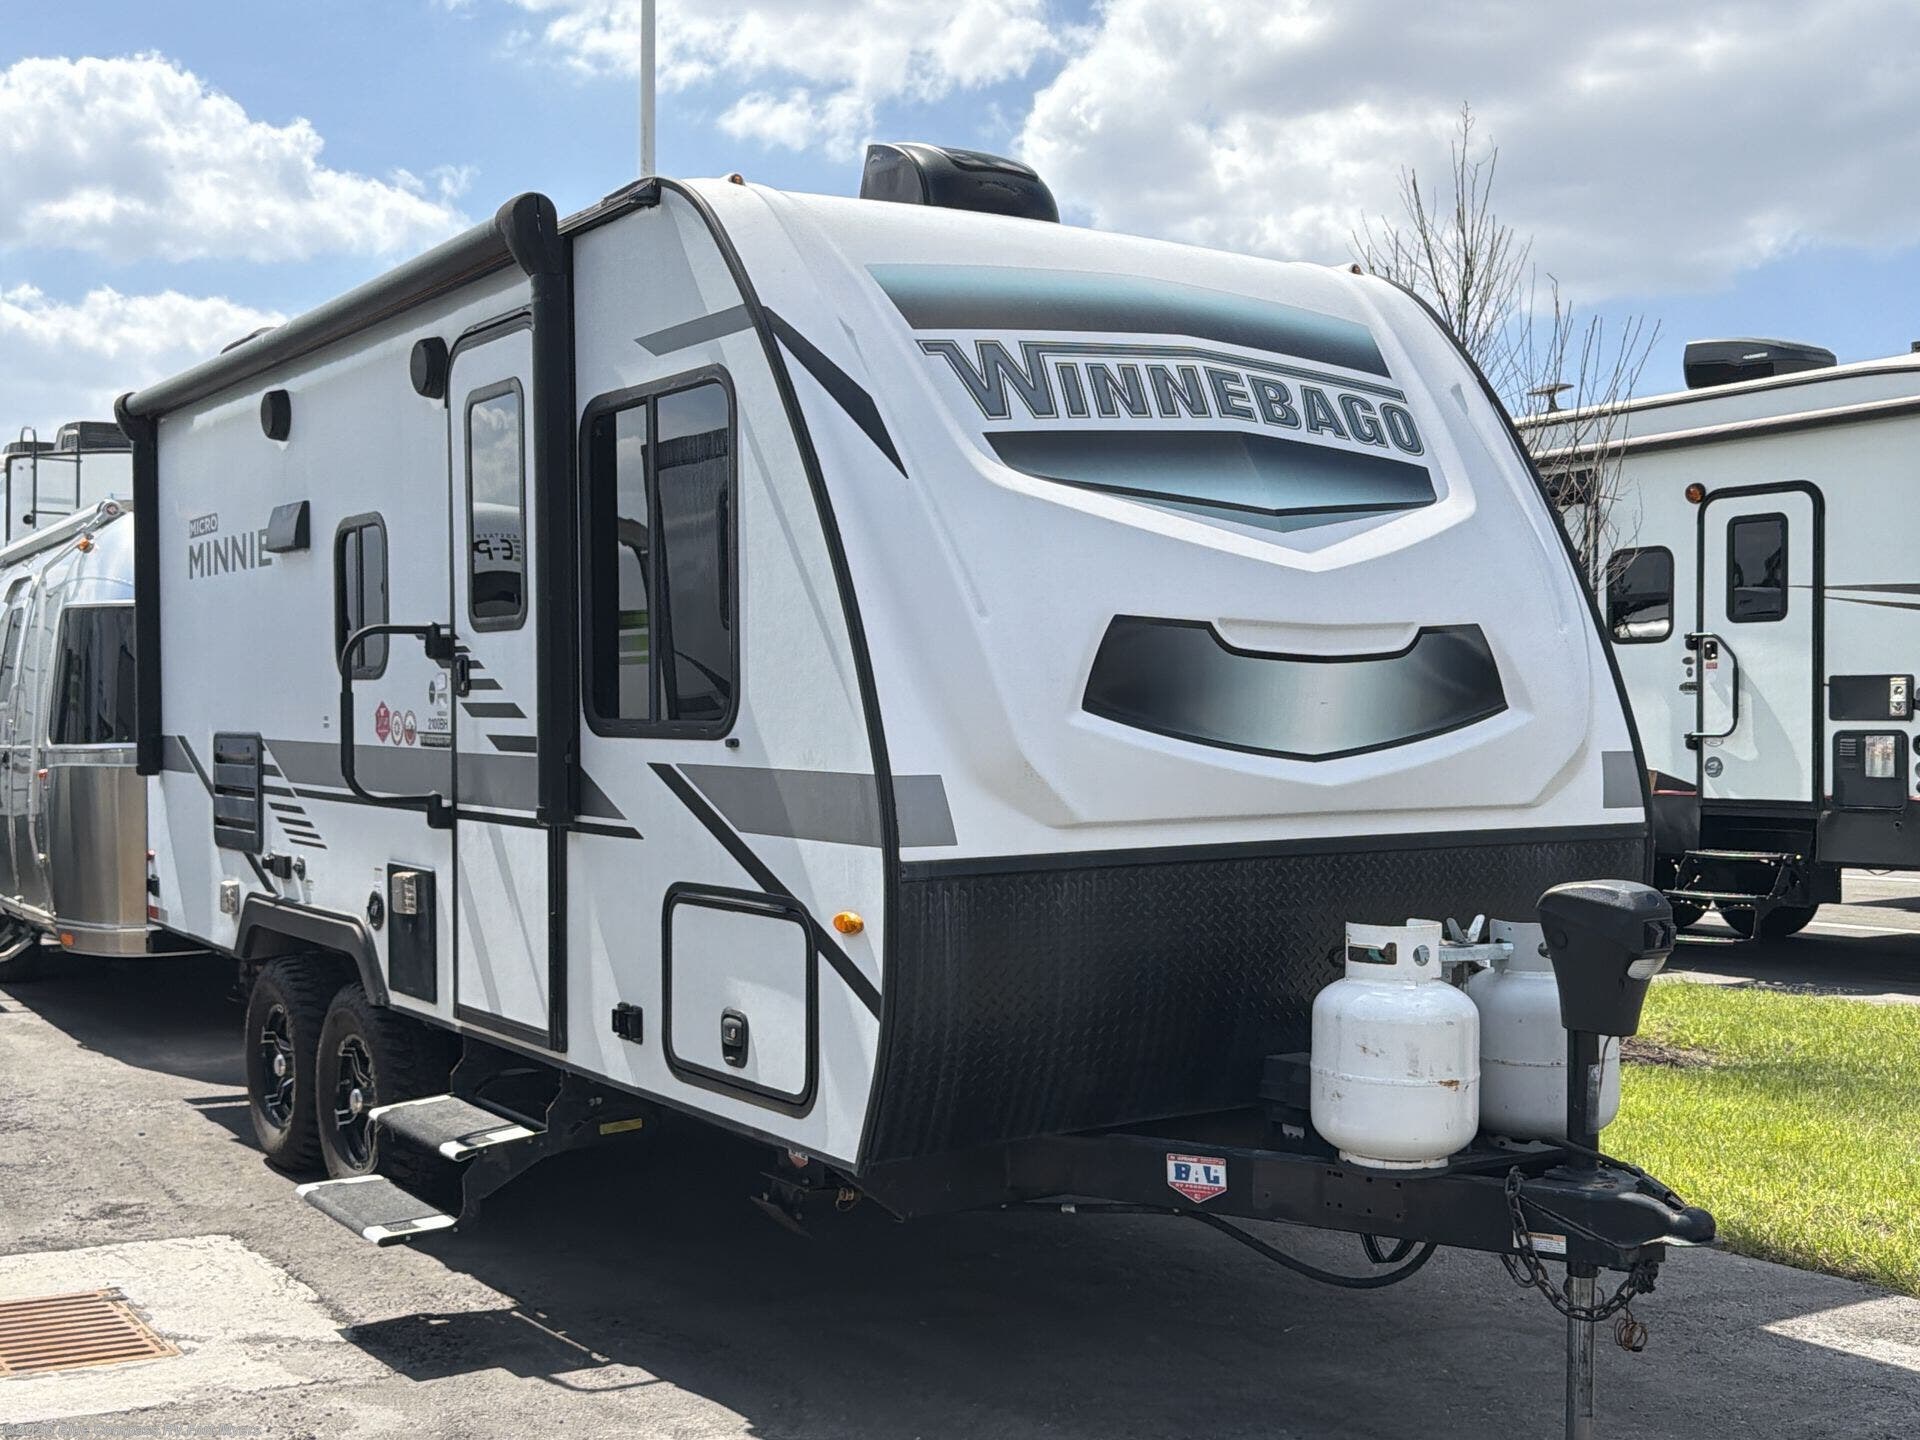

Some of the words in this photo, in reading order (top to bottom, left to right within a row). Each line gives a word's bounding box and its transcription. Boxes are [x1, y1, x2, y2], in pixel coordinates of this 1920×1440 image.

[917, 339, 1425, 457] WINNEBAGO
[190, 515, 218, 537] MICRO
[189, 530, 272, 580] MINNIE
